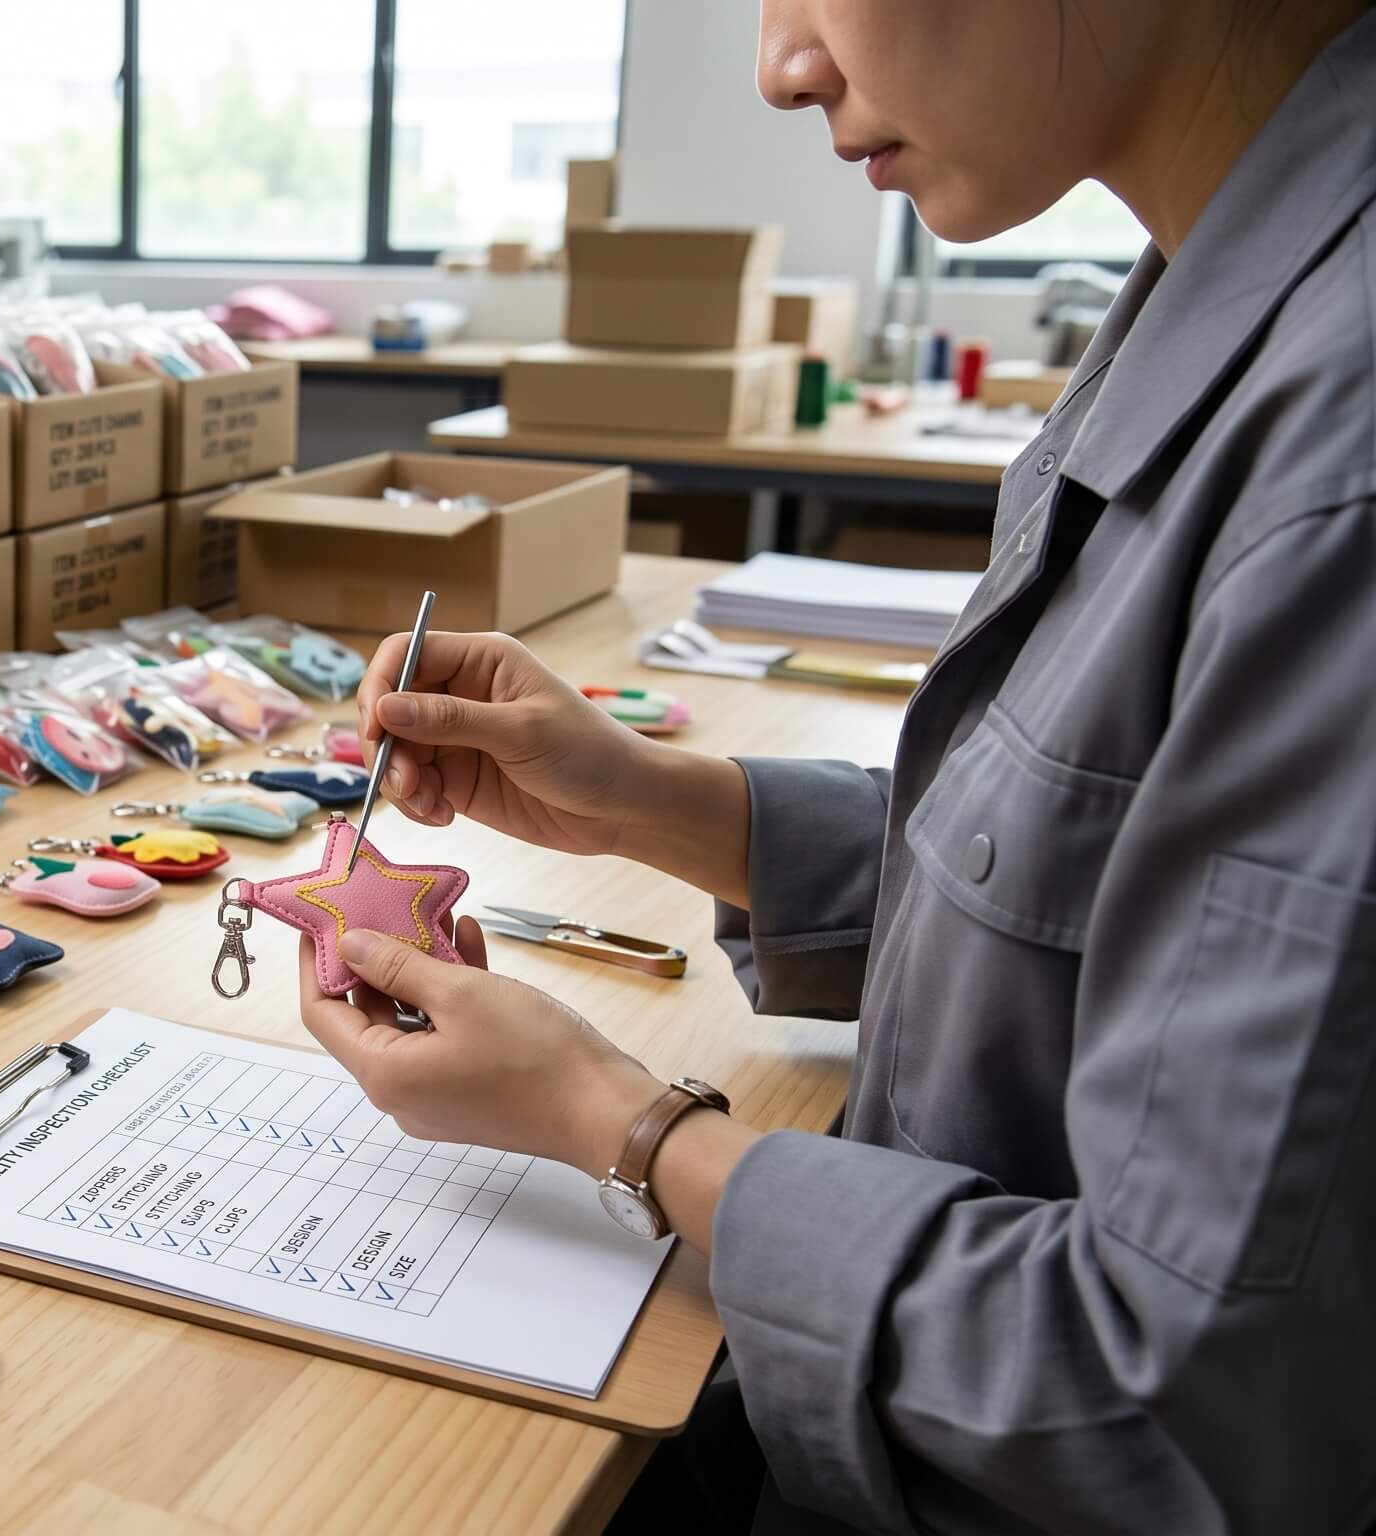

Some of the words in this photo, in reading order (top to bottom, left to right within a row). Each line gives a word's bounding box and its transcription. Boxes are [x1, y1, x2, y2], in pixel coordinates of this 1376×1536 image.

[16, 1090, 99, 1152] INSPECTION
[91, 1041, 157, 1091] CHECKLIST
[215, 1207, 248, 1234] CLIPS
[352, 1231, 393, 1271] DESIGN
[389, 1255, 417, 1279] SIZE
